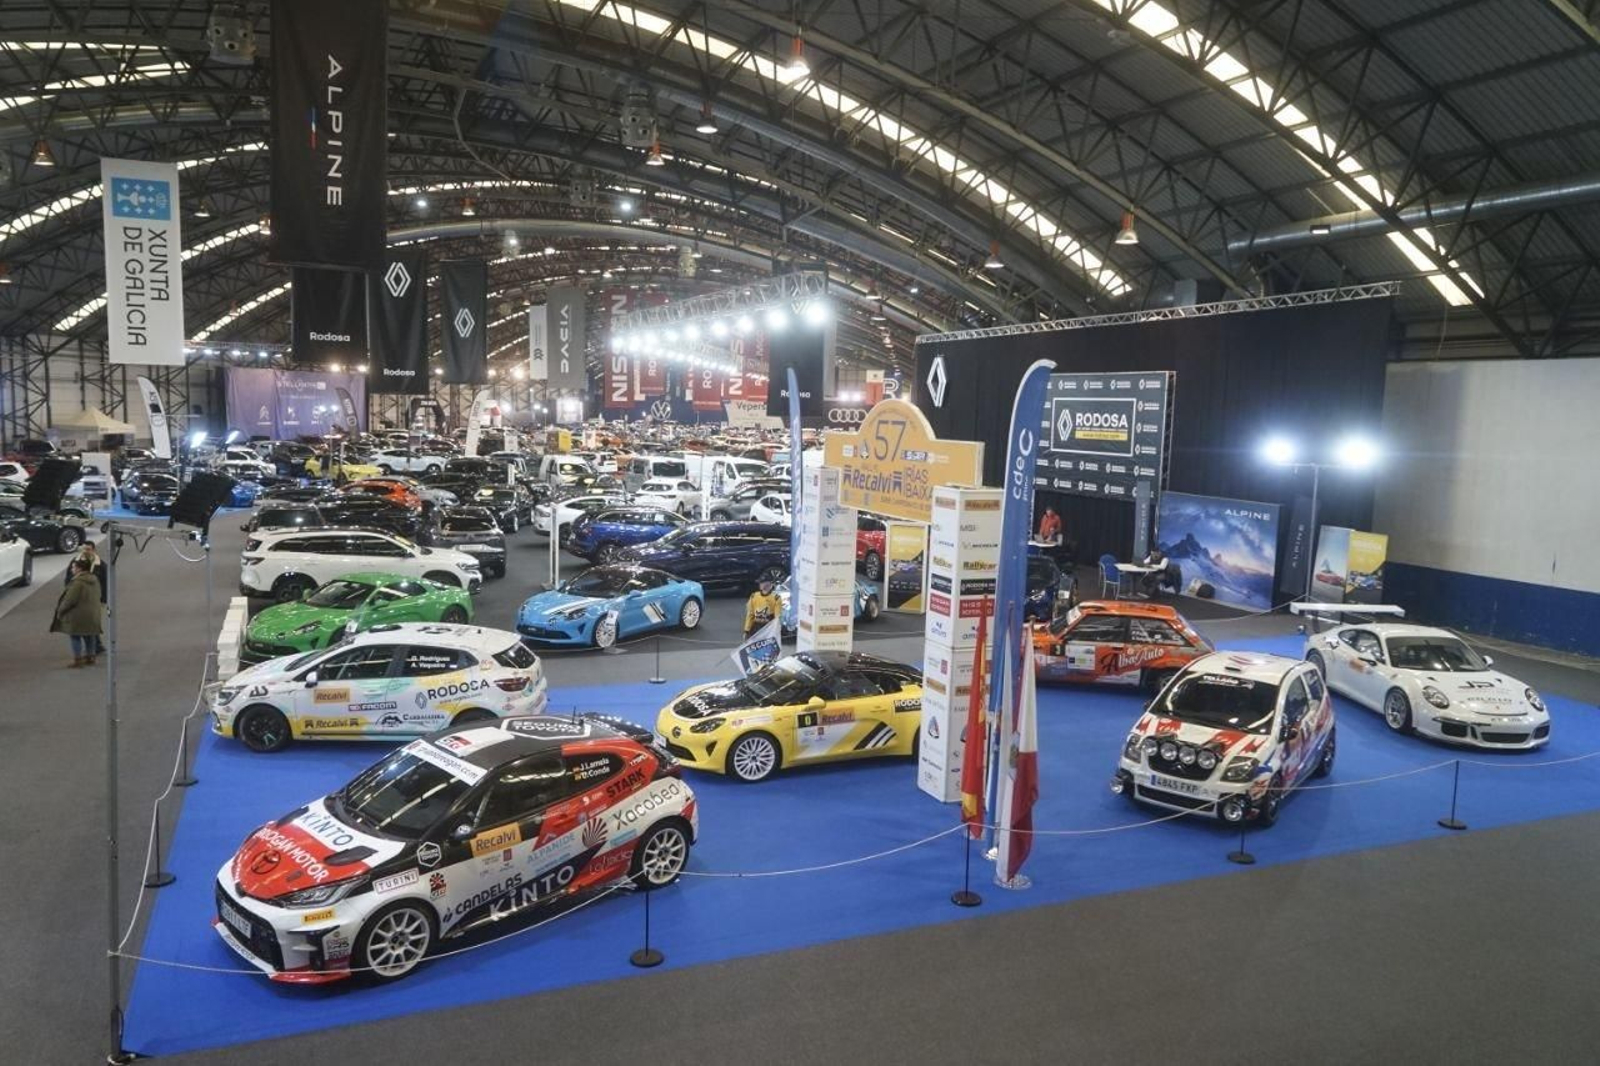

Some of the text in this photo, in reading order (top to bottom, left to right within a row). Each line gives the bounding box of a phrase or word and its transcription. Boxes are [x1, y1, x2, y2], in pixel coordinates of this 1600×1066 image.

[326, 54, 343, 206] ALPINE
[148, 228, 169, 302] XUNTA
[123, 226, 147, 347] DE GALICIA
[309, 331, 351, 342] Rodosa
[383, 368, 416, 377] Rodosa
[737, 398, 767, 411] Vepers
[1075, 412, 1128, 428] RODOSA
[873, 420, 907, 462] 57
[852, 468, 892, 494] Recalvi
[1224, 507, 1271, 521] ALPINE
[316, 691, 348, 701] Recalvi
[428, 679, 490, 700] RODOSA
[895, 699, 922, 707] RODO
[316, 719, 348, 728] Recalvi
[606, 768, 646, 798] STARK
[613, 783, 680, 831] Xacobeo
[475, 831, 516, 852] Recalvi
[291, 849, 330, 883] MOTOR
[378, 872, 417, 891] TURINI
[455, 872, 523, 916] CANDELAS
